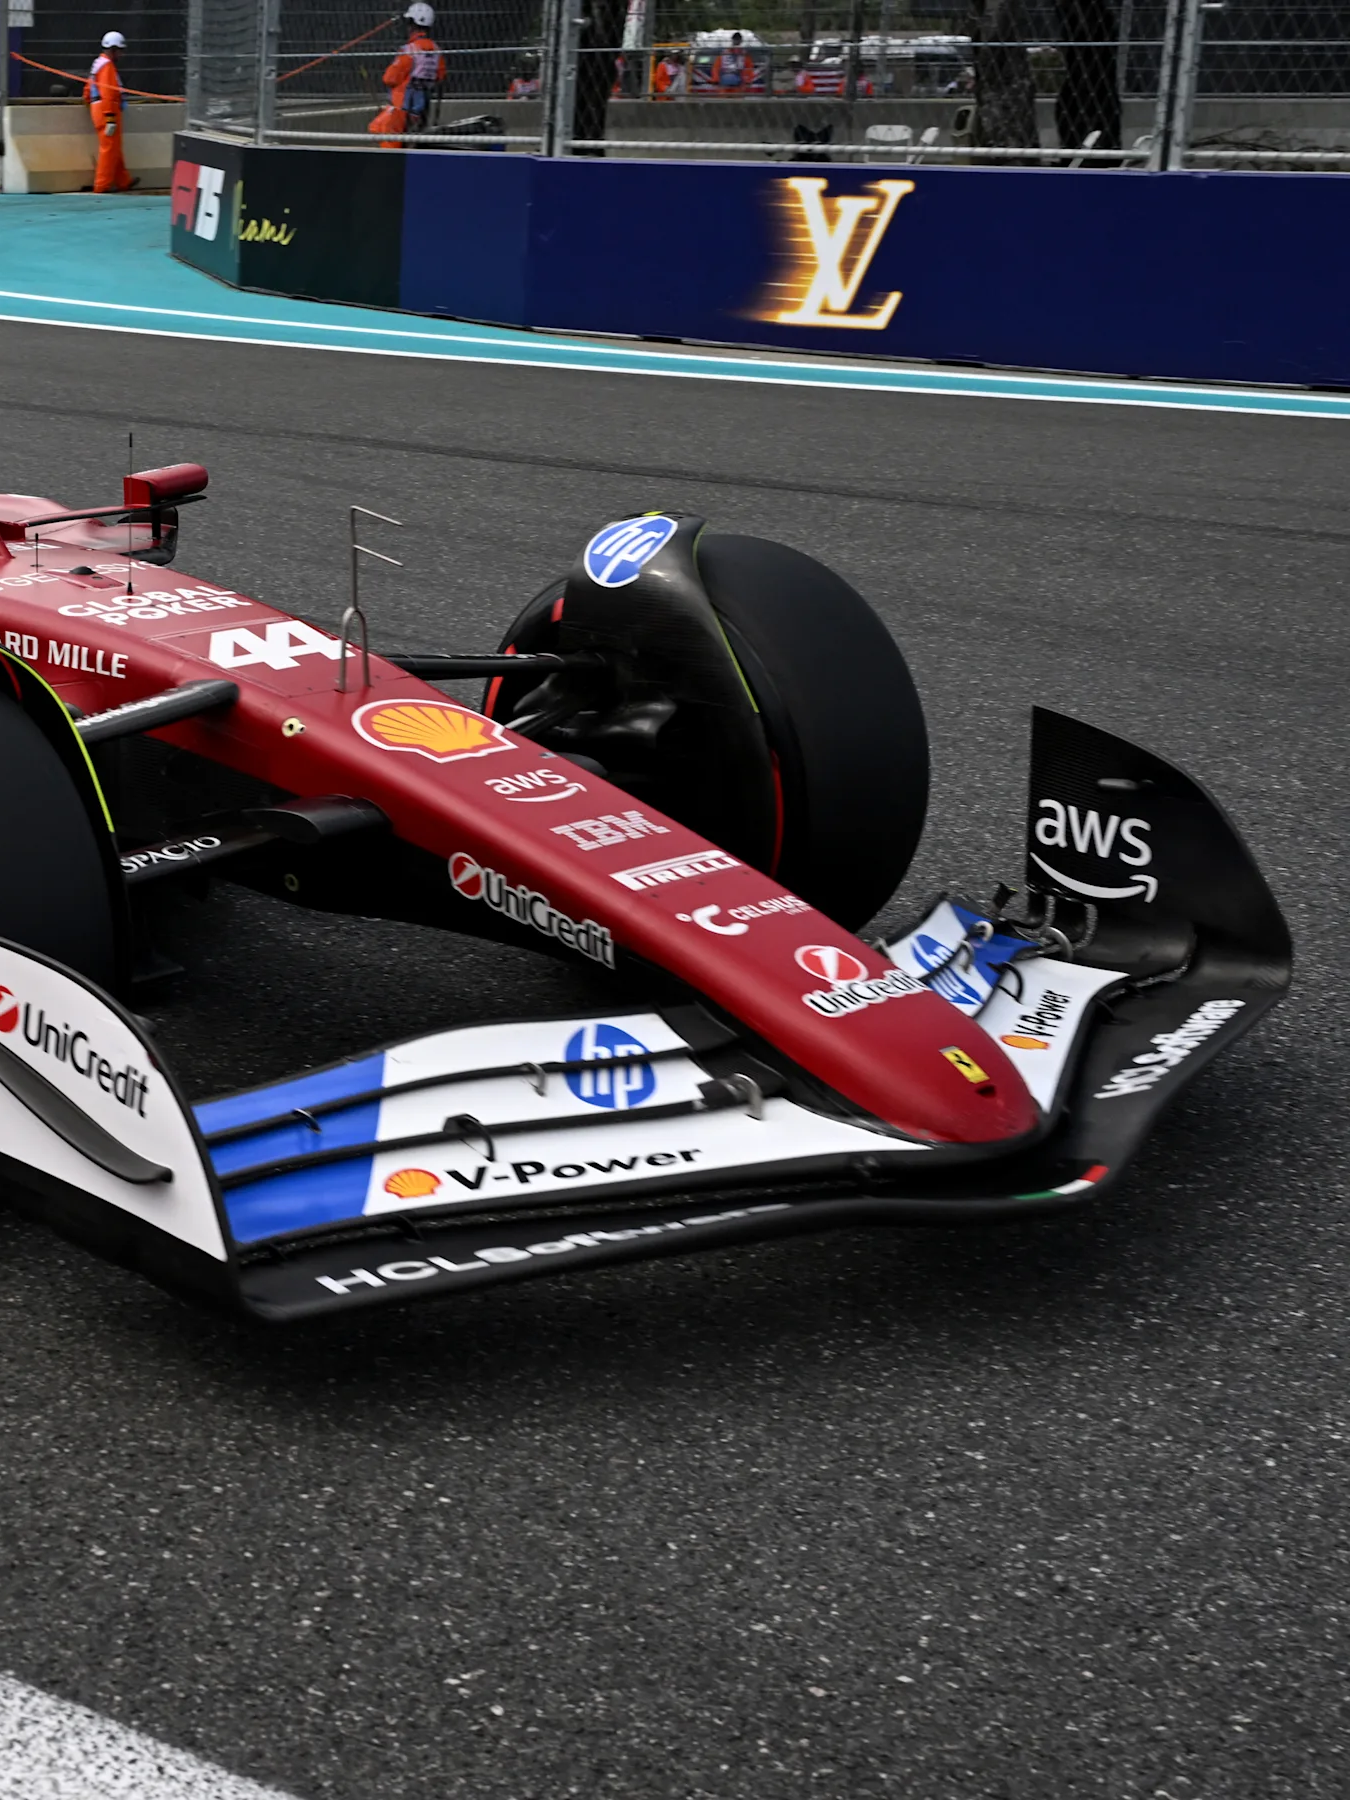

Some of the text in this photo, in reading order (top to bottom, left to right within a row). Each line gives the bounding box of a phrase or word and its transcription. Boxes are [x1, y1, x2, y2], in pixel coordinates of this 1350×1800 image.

[591, 517, 665, 584] hp
[58, 585, 236, 618] GLOBAL
[96, 596, 253, 626] POKER
[48, 640, 129, 679] MILLE
[208, 619, 356, 671] 44
[484, 769, 571, 797] aws
[550, 811, 672, 850] IBM
[1035, 799, 1152, 867] aws
[610, 849, 743, 891] PIRELLI
[482, 868, 616, 969] UniCredit
[727, 895, 808, 920] CELSIUS
[804, 968, 925, 1017] UniCredit
[1014, 989, 1072, 1037] V-Power
[23, 1001, 150, 1119] UniCredit
[581, 1024, 648, 1109] hp
[446, 1146, 703, 1190] V-Power
